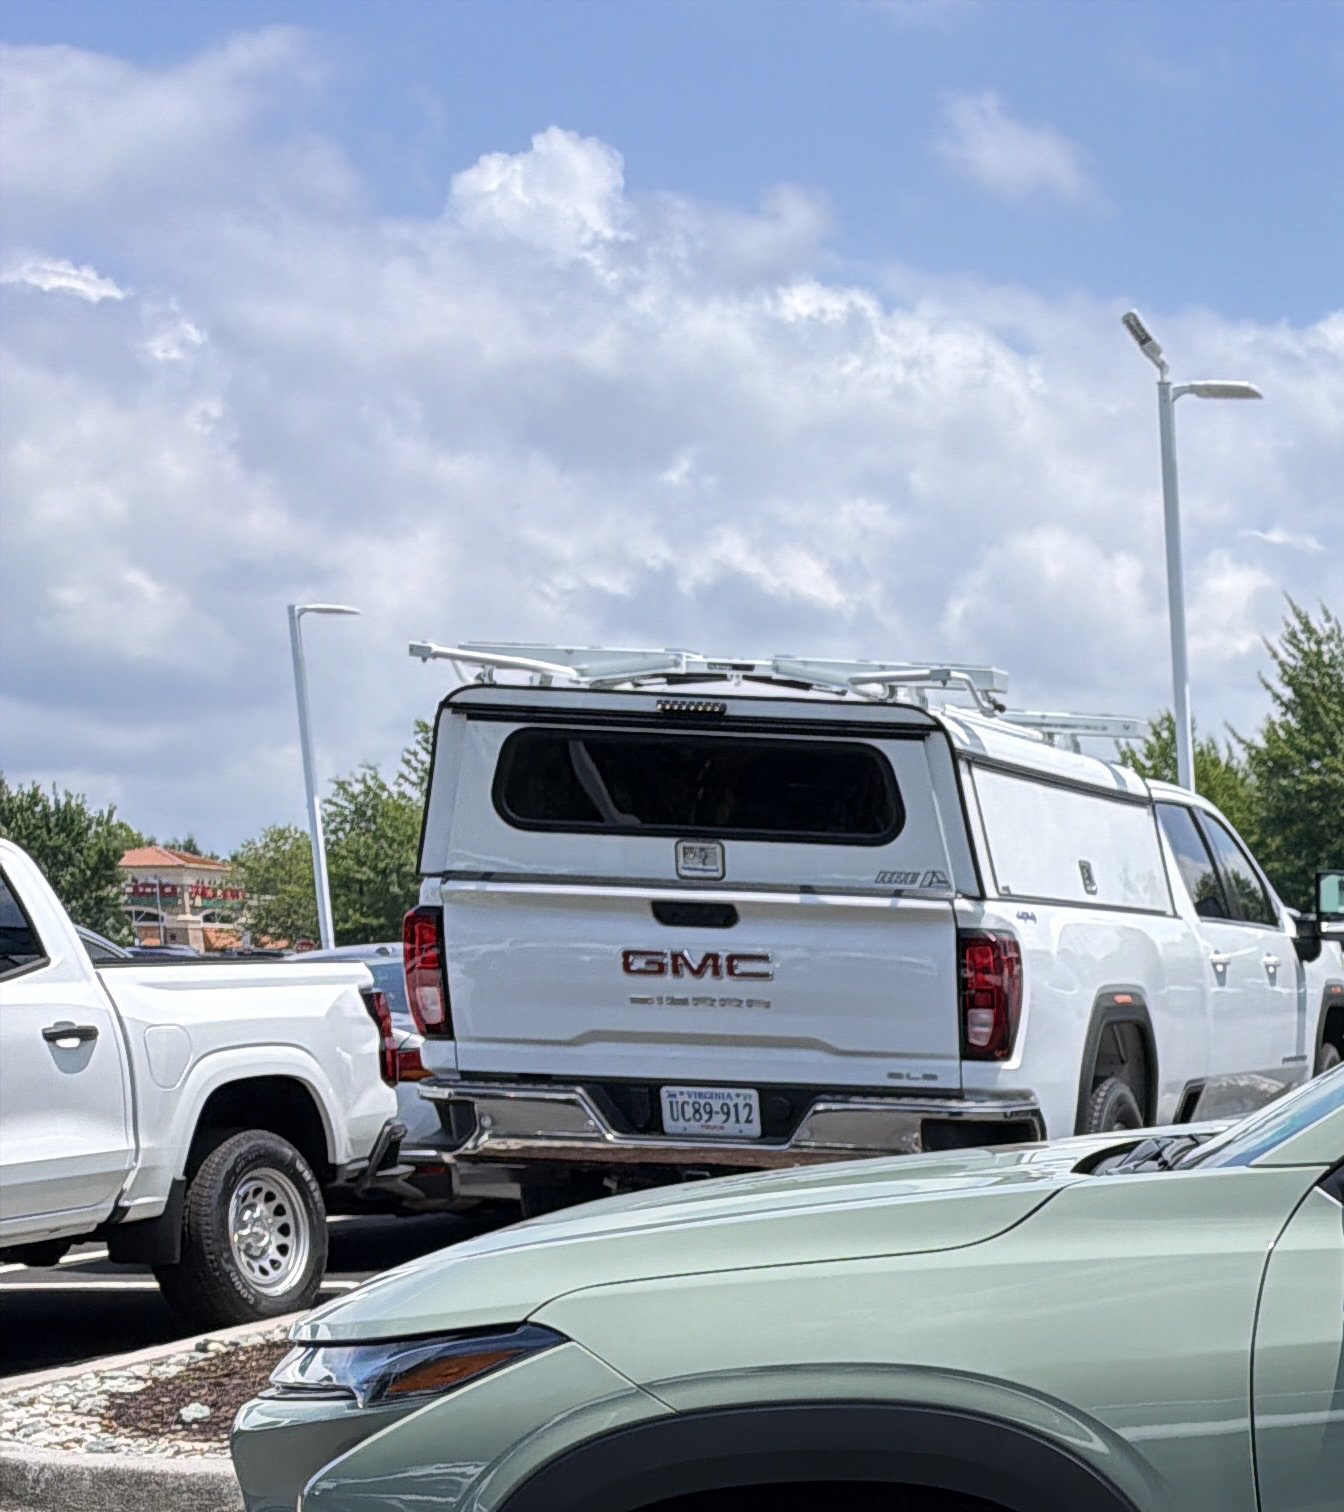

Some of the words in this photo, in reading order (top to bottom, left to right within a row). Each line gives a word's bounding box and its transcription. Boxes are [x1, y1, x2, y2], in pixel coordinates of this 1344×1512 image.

[621, 949, 775, 981] GMC
[686, 1090, 733, 1101] VIRGINIA
[668, 1100, 754, 1125] UC89-912
